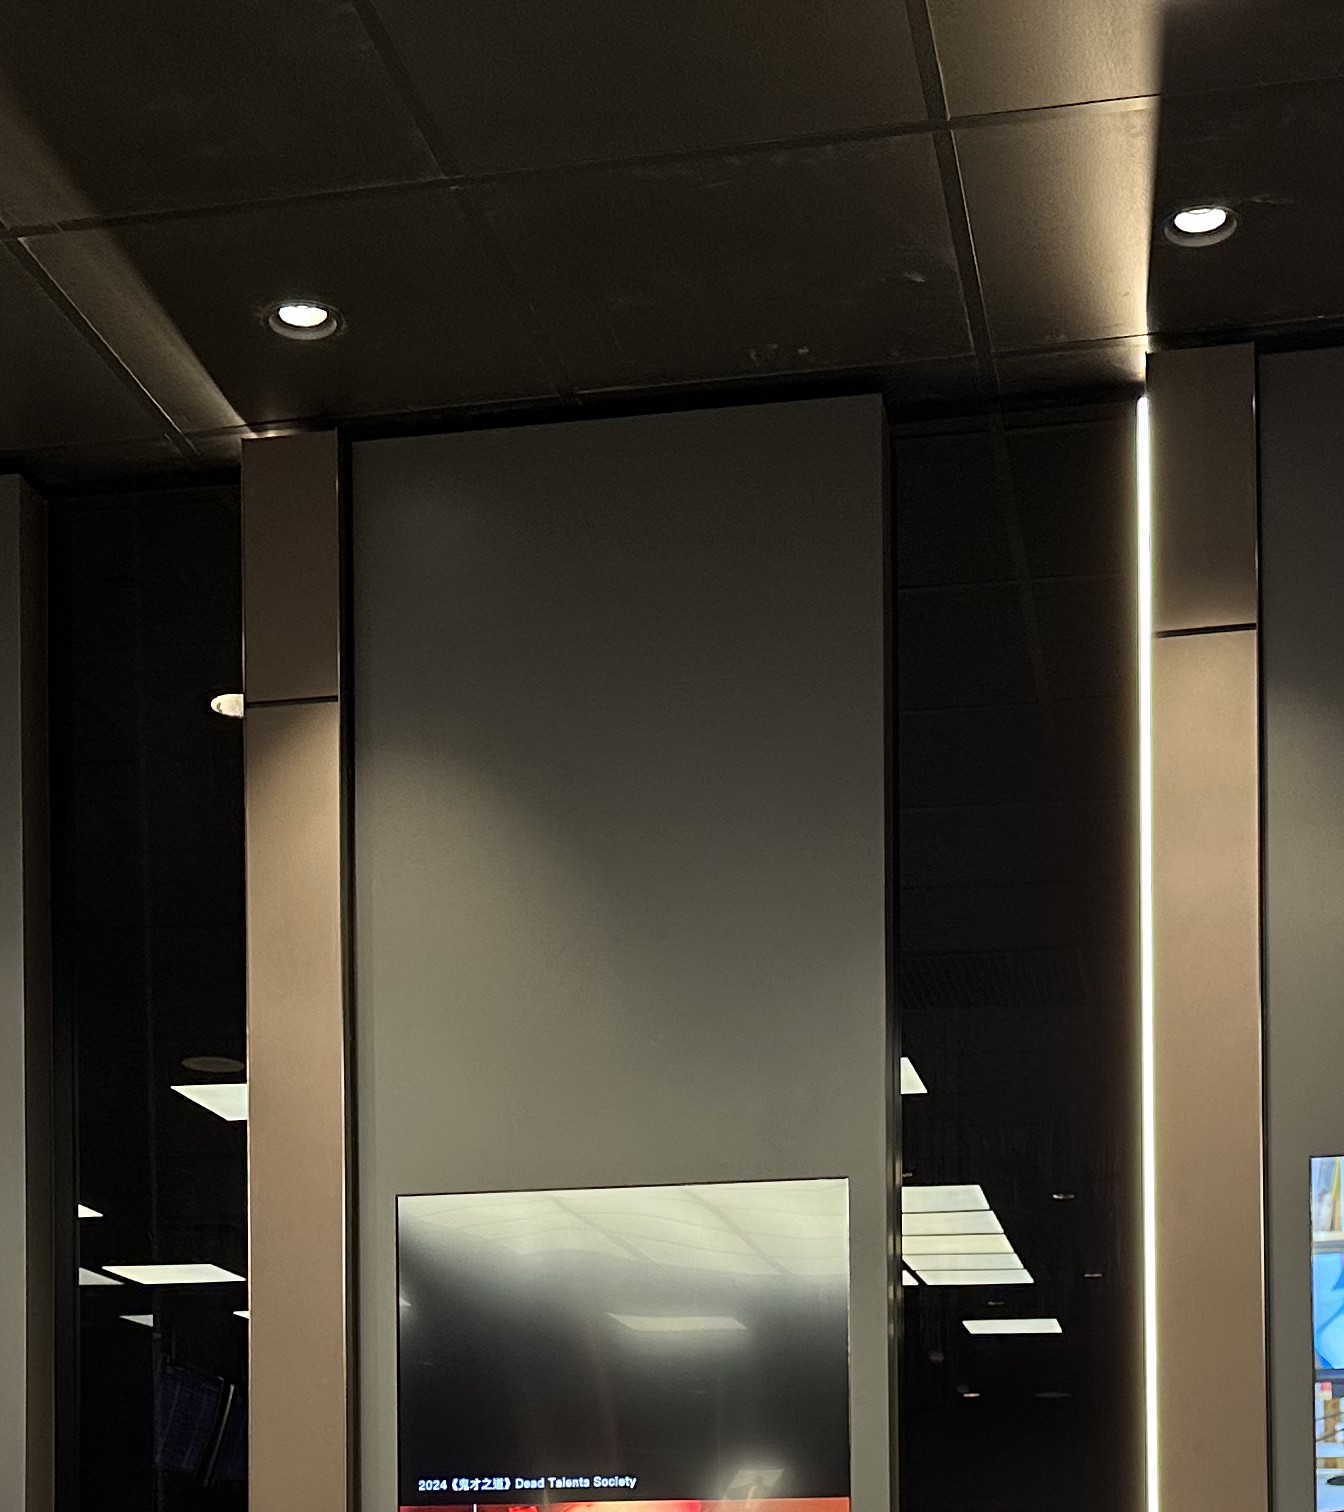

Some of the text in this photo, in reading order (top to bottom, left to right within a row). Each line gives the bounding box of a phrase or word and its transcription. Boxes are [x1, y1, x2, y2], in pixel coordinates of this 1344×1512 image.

[418, 1480, 447, 1491] 2024
[515, 1477, 545, 1489] Dead
[548, 1476, 590, 1489] Talents
[593, 1475, 637, 1489] Society
